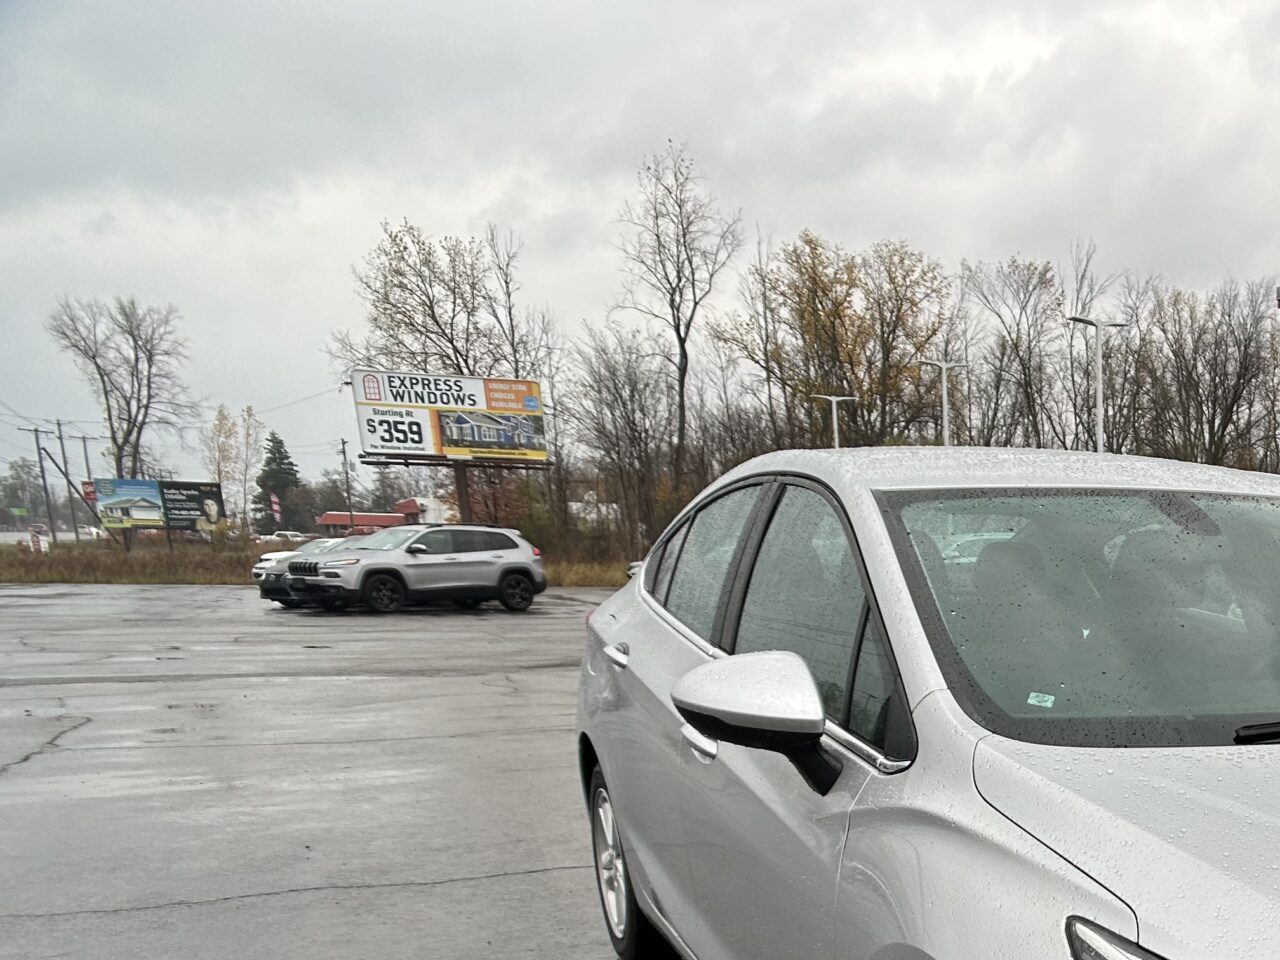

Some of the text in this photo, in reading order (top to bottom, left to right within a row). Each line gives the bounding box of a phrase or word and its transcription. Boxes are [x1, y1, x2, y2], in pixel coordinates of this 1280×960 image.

[387, 375, 463, 392] EXPRESS
[389, 389, 477, 406] WINDOWS
[372, 408, 403, 418] Starting
[366, 418, 423, 445] $359
